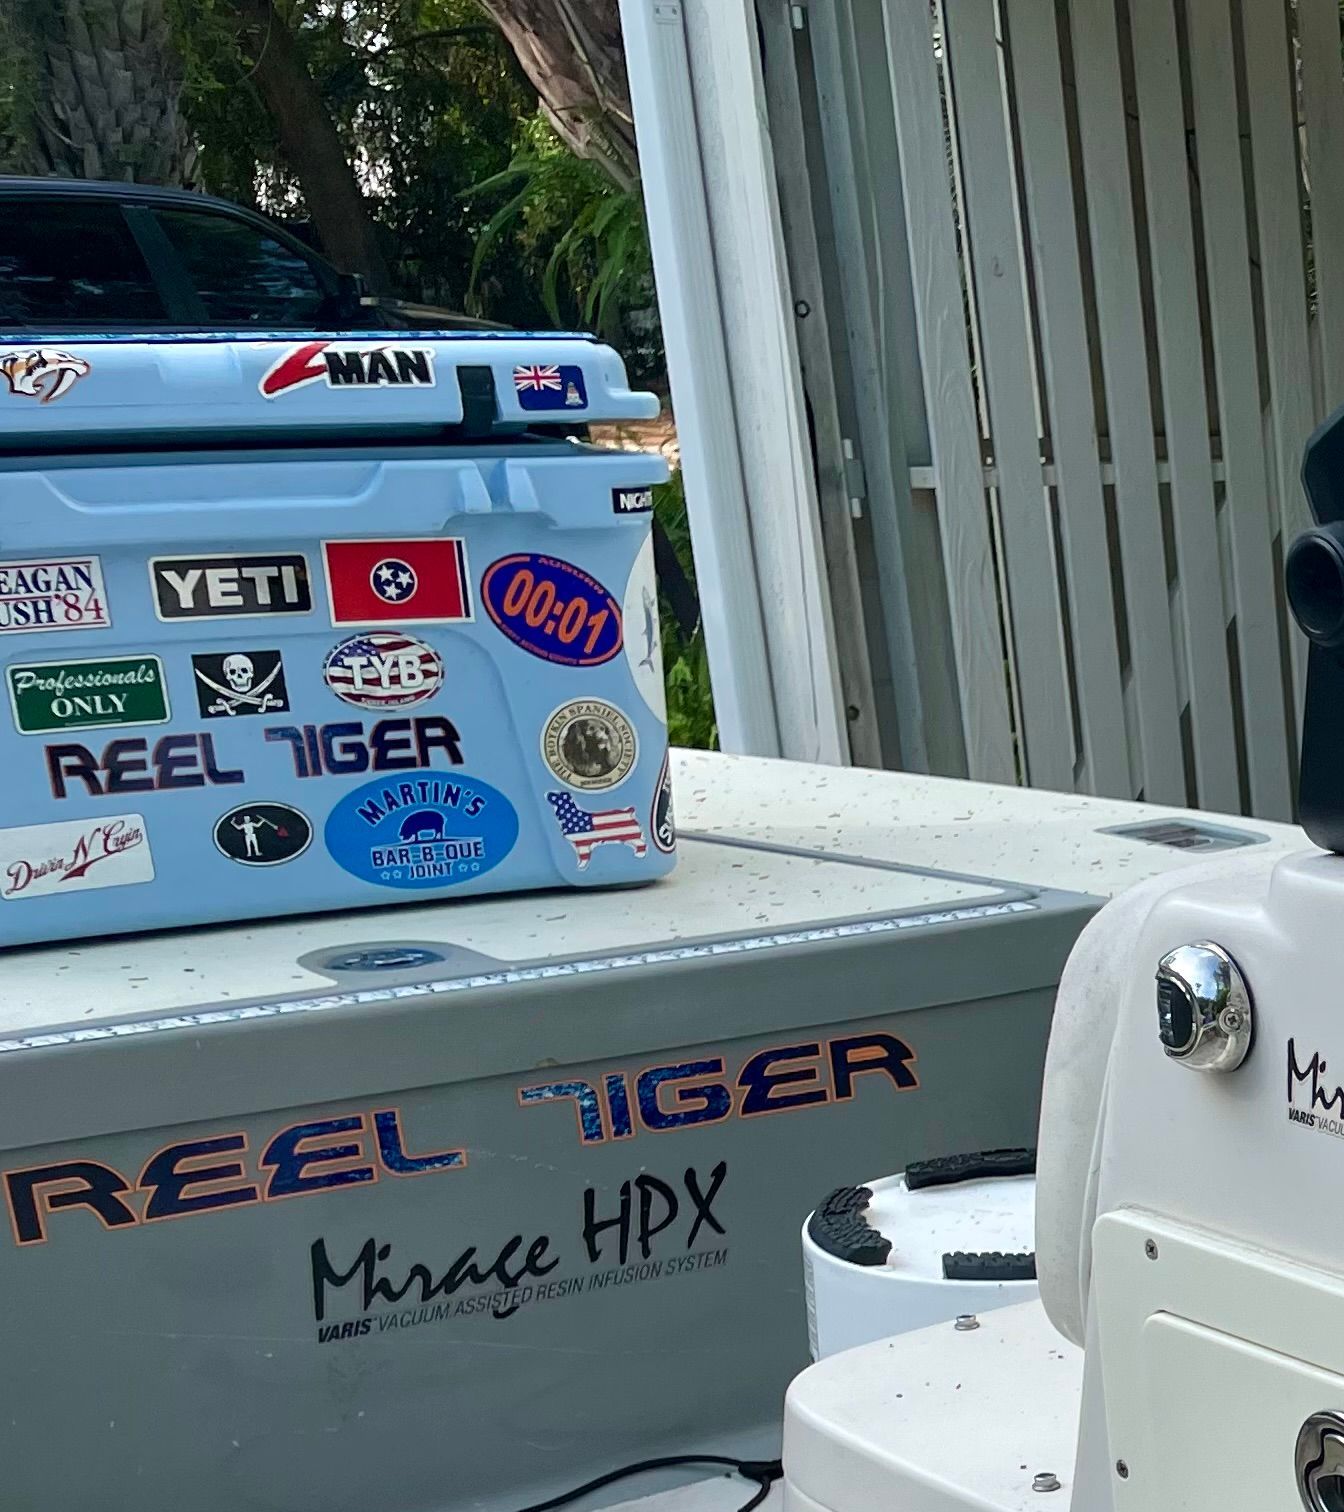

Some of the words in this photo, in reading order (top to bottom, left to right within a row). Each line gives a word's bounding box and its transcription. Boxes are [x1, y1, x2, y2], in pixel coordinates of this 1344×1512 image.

[160, 565, 299, 610] YETI
[503, 568, 609, 655] 00:01
[14, 663, 156, 697] Professionals
[343, 654, 425, 690] TYB
[51, 692, 128, 718] ONLY
[568, 704, 619, 722] SPANIEL
[44, 732, 245, 799] REEL
[263, 715, 465, 777] TIGER
[356, 780, 487, 827] MARTIN'S
[409, 861, 453, 880] JOINT
[2, 1108, 467, 1245] REEL
[518, 1030, 920, 1145] TIGER
[1288, 1107, 1315, 1127] VARIS
[311, 1235, 560, 1321] Mirage
[583, 1160, 727, 1265] HPX
[318, 1317, 373, 1344] VARIS
[378, 1303, 451, 1332] VACUUM
[454, 1286, 532, 1316] ASSISTED
[536, 1277, 584, 1301] RESIN
[588, 1260, 662, 1289] INFUSION
[665, 1248, 728, 1276] SYSTEM
